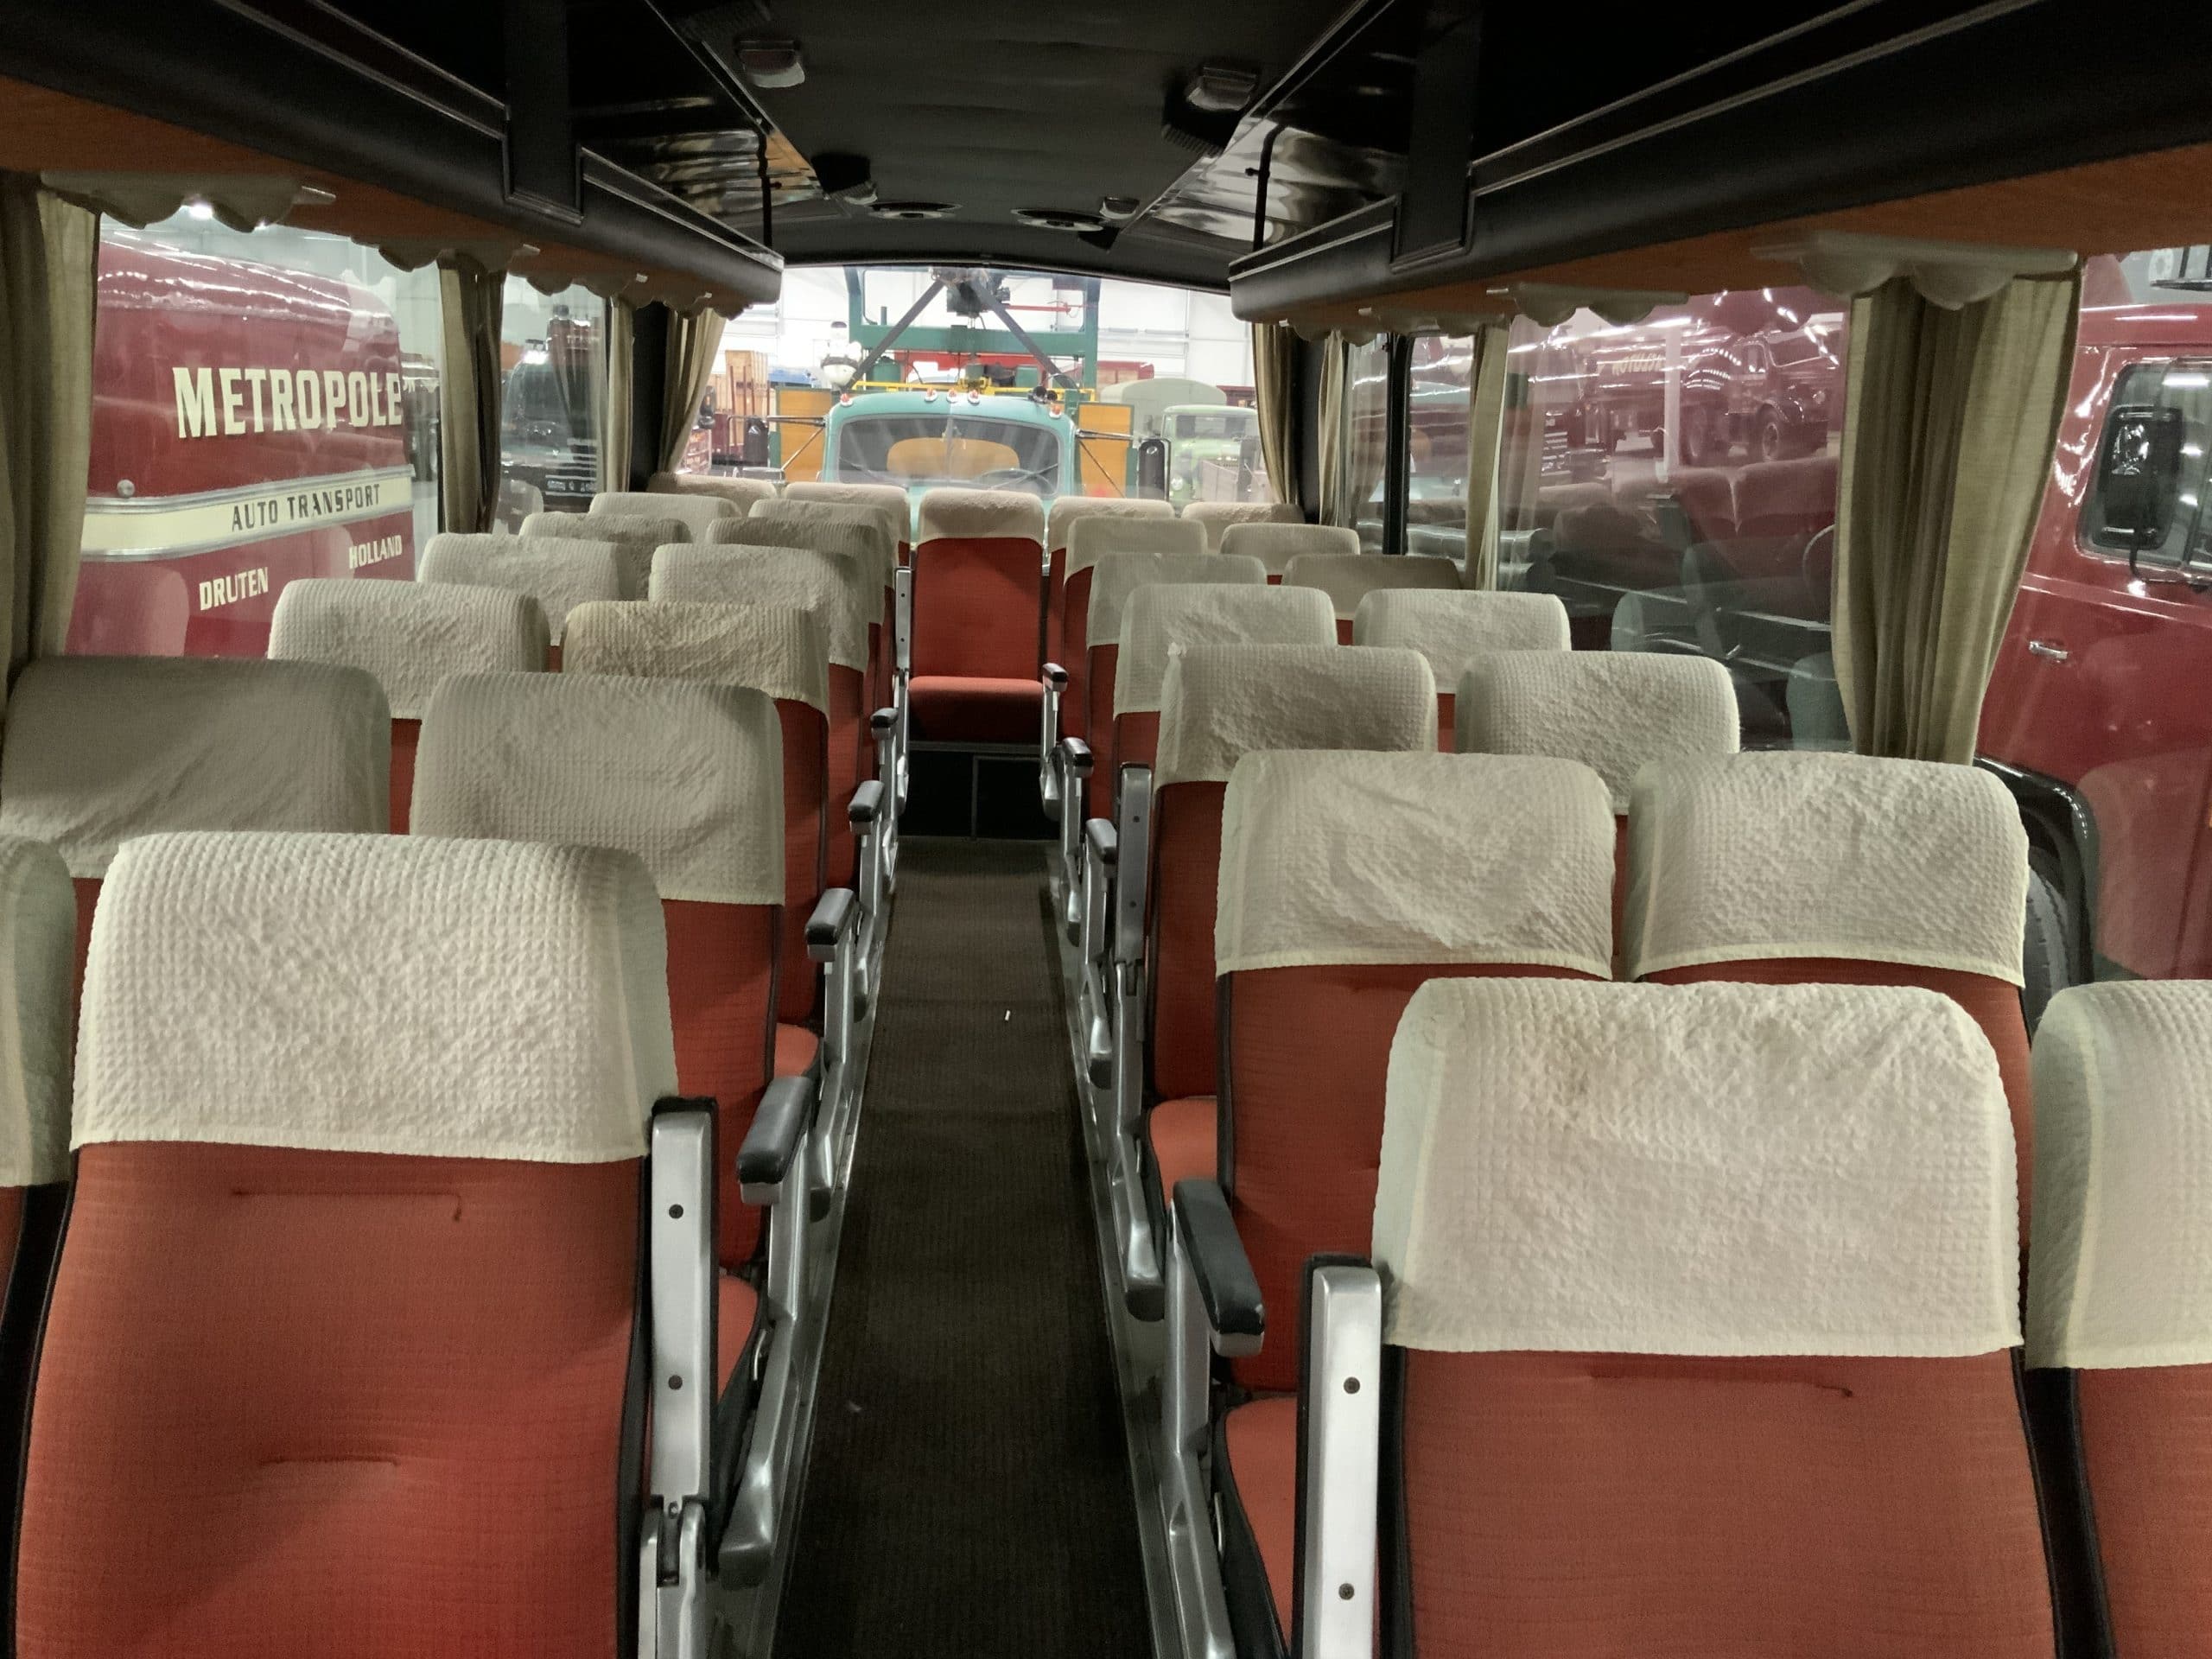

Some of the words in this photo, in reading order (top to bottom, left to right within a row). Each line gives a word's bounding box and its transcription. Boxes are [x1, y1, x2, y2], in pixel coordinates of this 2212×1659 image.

[172, 367, 403, 439] METROPOLE
[232, 499, 279, 531] AUTO
[287, 484, 380, 520] TRANSPORT
[199, 567, 269, 610] DRUTEN
[349, 535, 402, 569] HOLLAND
